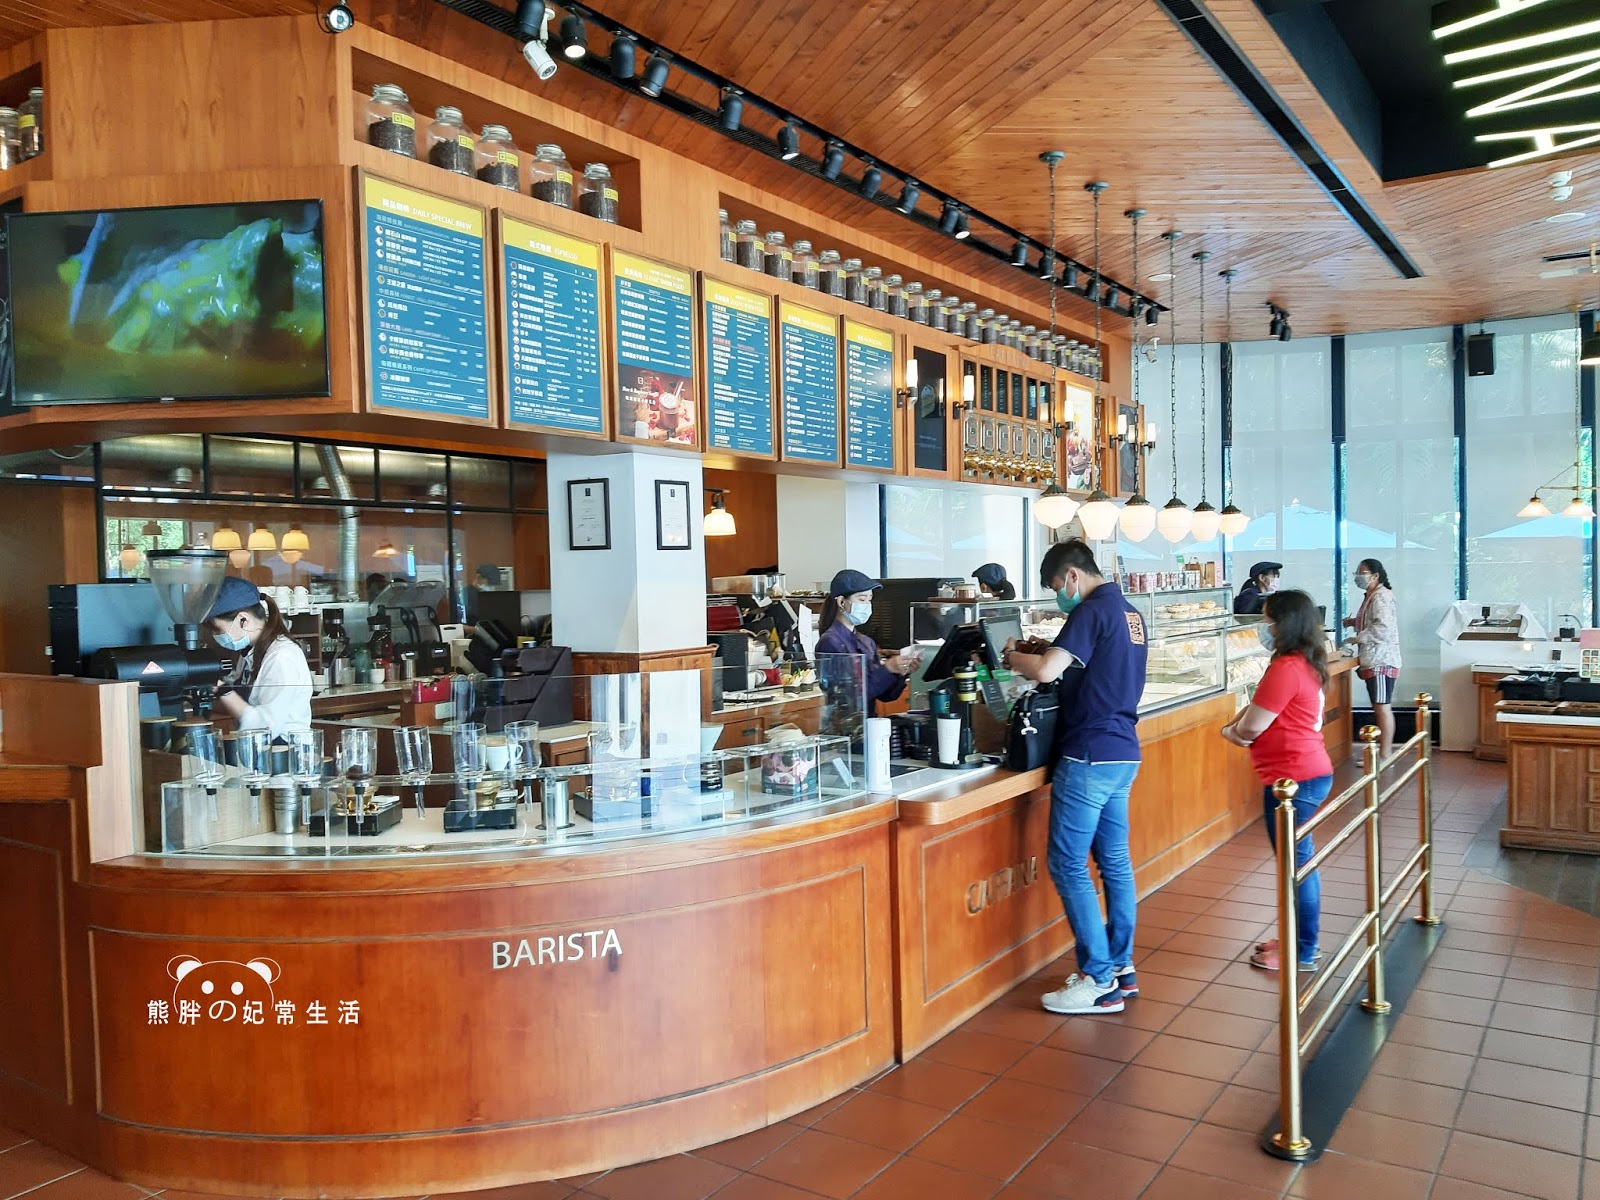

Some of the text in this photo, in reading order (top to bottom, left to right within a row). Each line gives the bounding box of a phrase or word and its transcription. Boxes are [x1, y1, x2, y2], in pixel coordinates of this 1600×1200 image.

[412, 208, 472, 230] DAILY SPECIAL BREW
[492, 928, 623, 970] BARISTA
